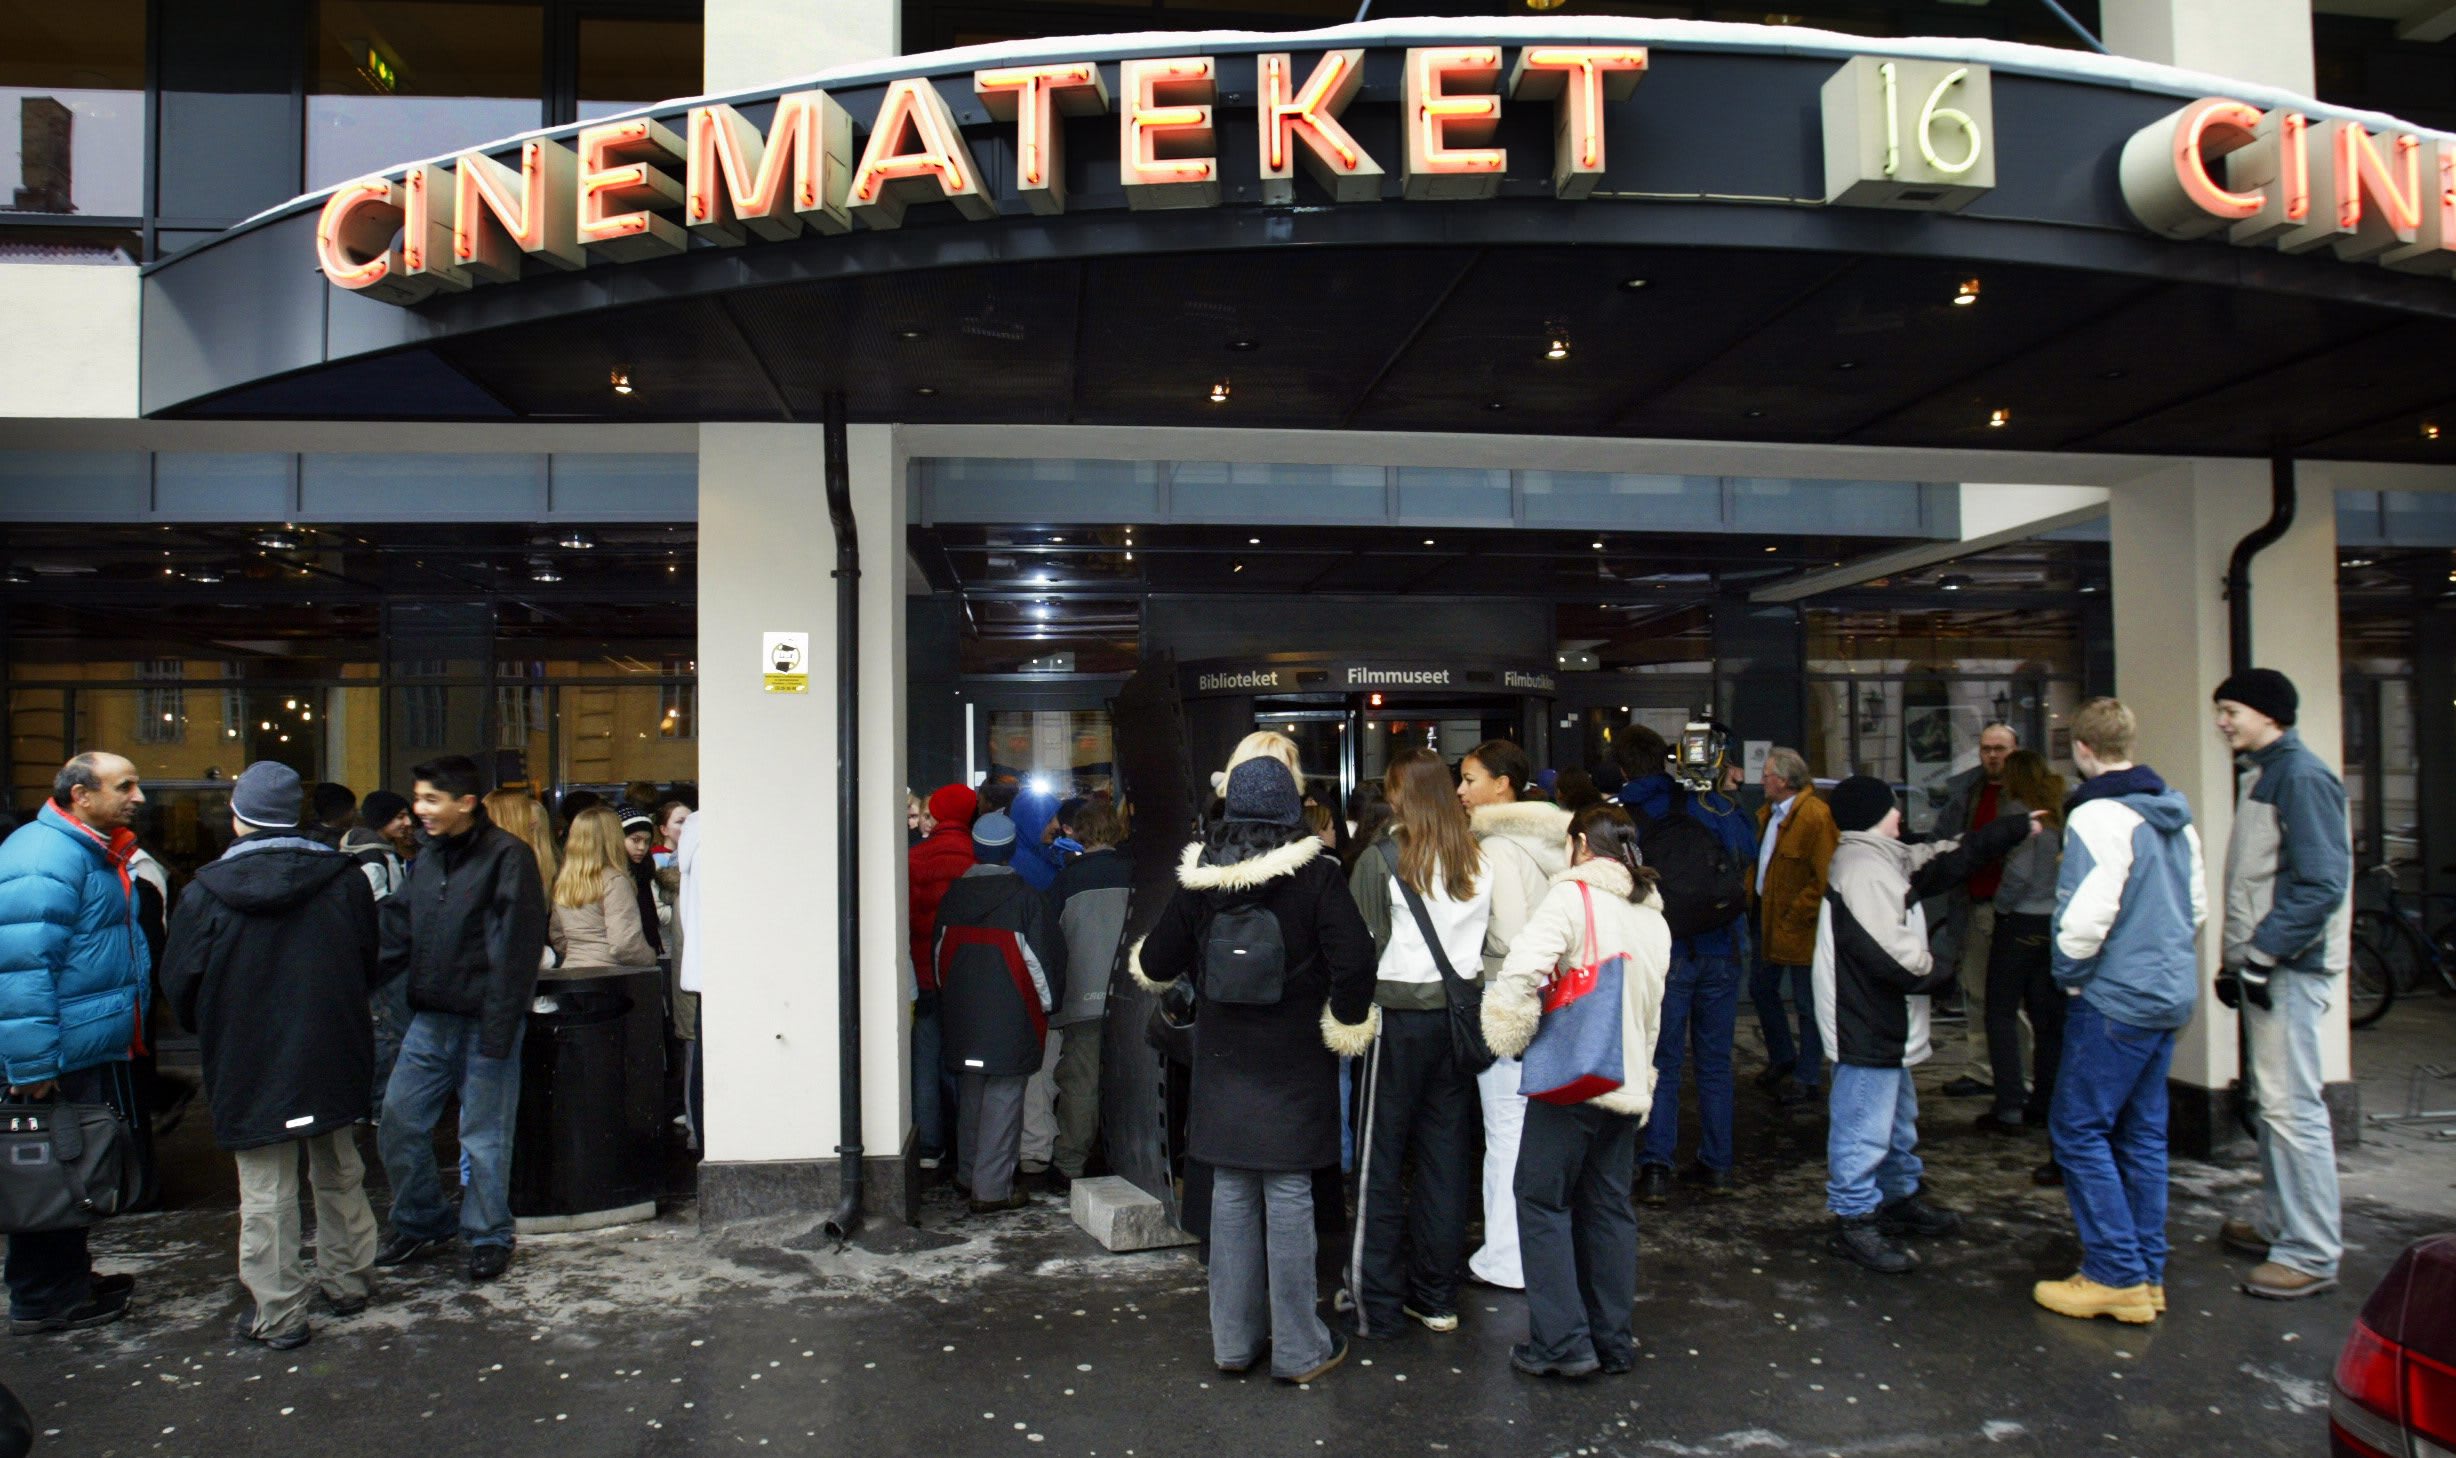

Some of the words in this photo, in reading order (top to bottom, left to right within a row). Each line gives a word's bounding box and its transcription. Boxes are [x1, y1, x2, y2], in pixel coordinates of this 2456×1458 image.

[1879, 62, 1982, 175] 16
[317, 46, 1649, 291] CINEMATEKET
[1199, 670, 1279, 690] Biblioteket
[1347, 667, 1450, 684] Filmmuseet
